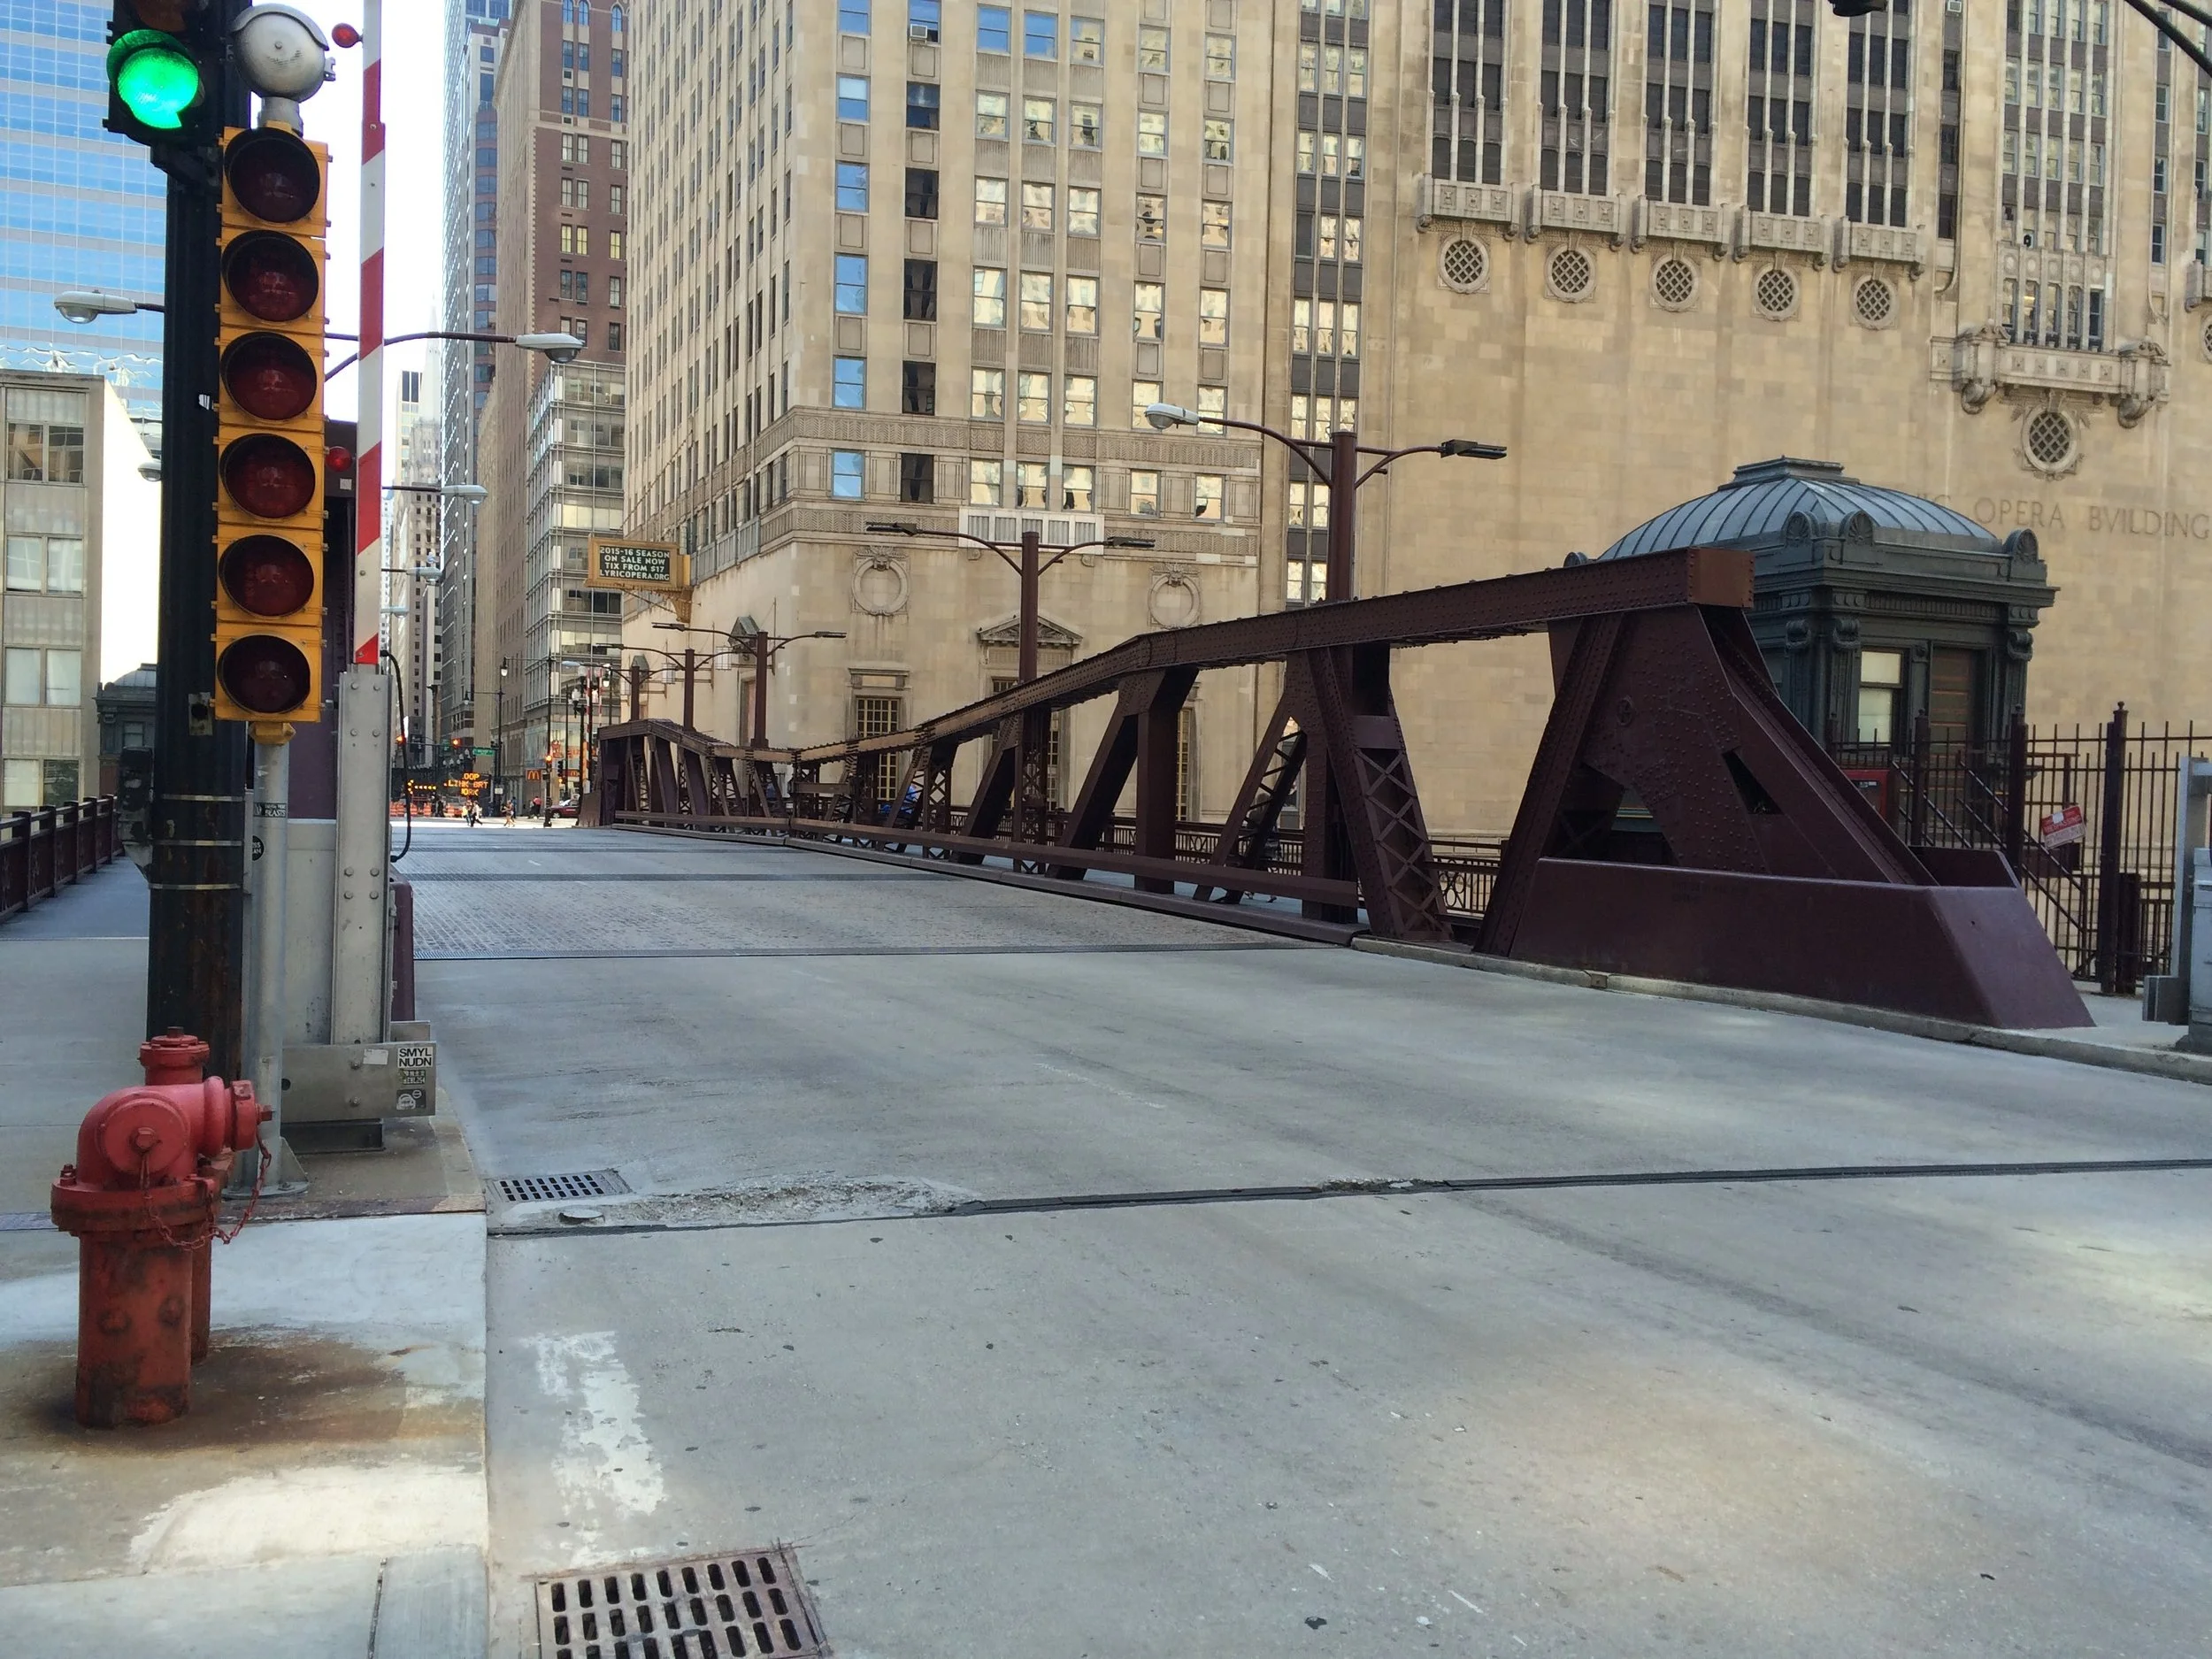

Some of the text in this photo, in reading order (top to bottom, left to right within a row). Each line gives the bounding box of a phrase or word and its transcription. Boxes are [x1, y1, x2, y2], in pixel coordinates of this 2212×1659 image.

[1973, 497, 2066, 529] OPERA
[600, 547, 670, 558] 2015-16 SEASON
[620, 556, 641, 565] SALE
[600, 570, 670, 580] LYRICOPERA.ORG
[399, 1048, 432, 1057] SMYL
[399, 1057, 432, 1067] NUDN
